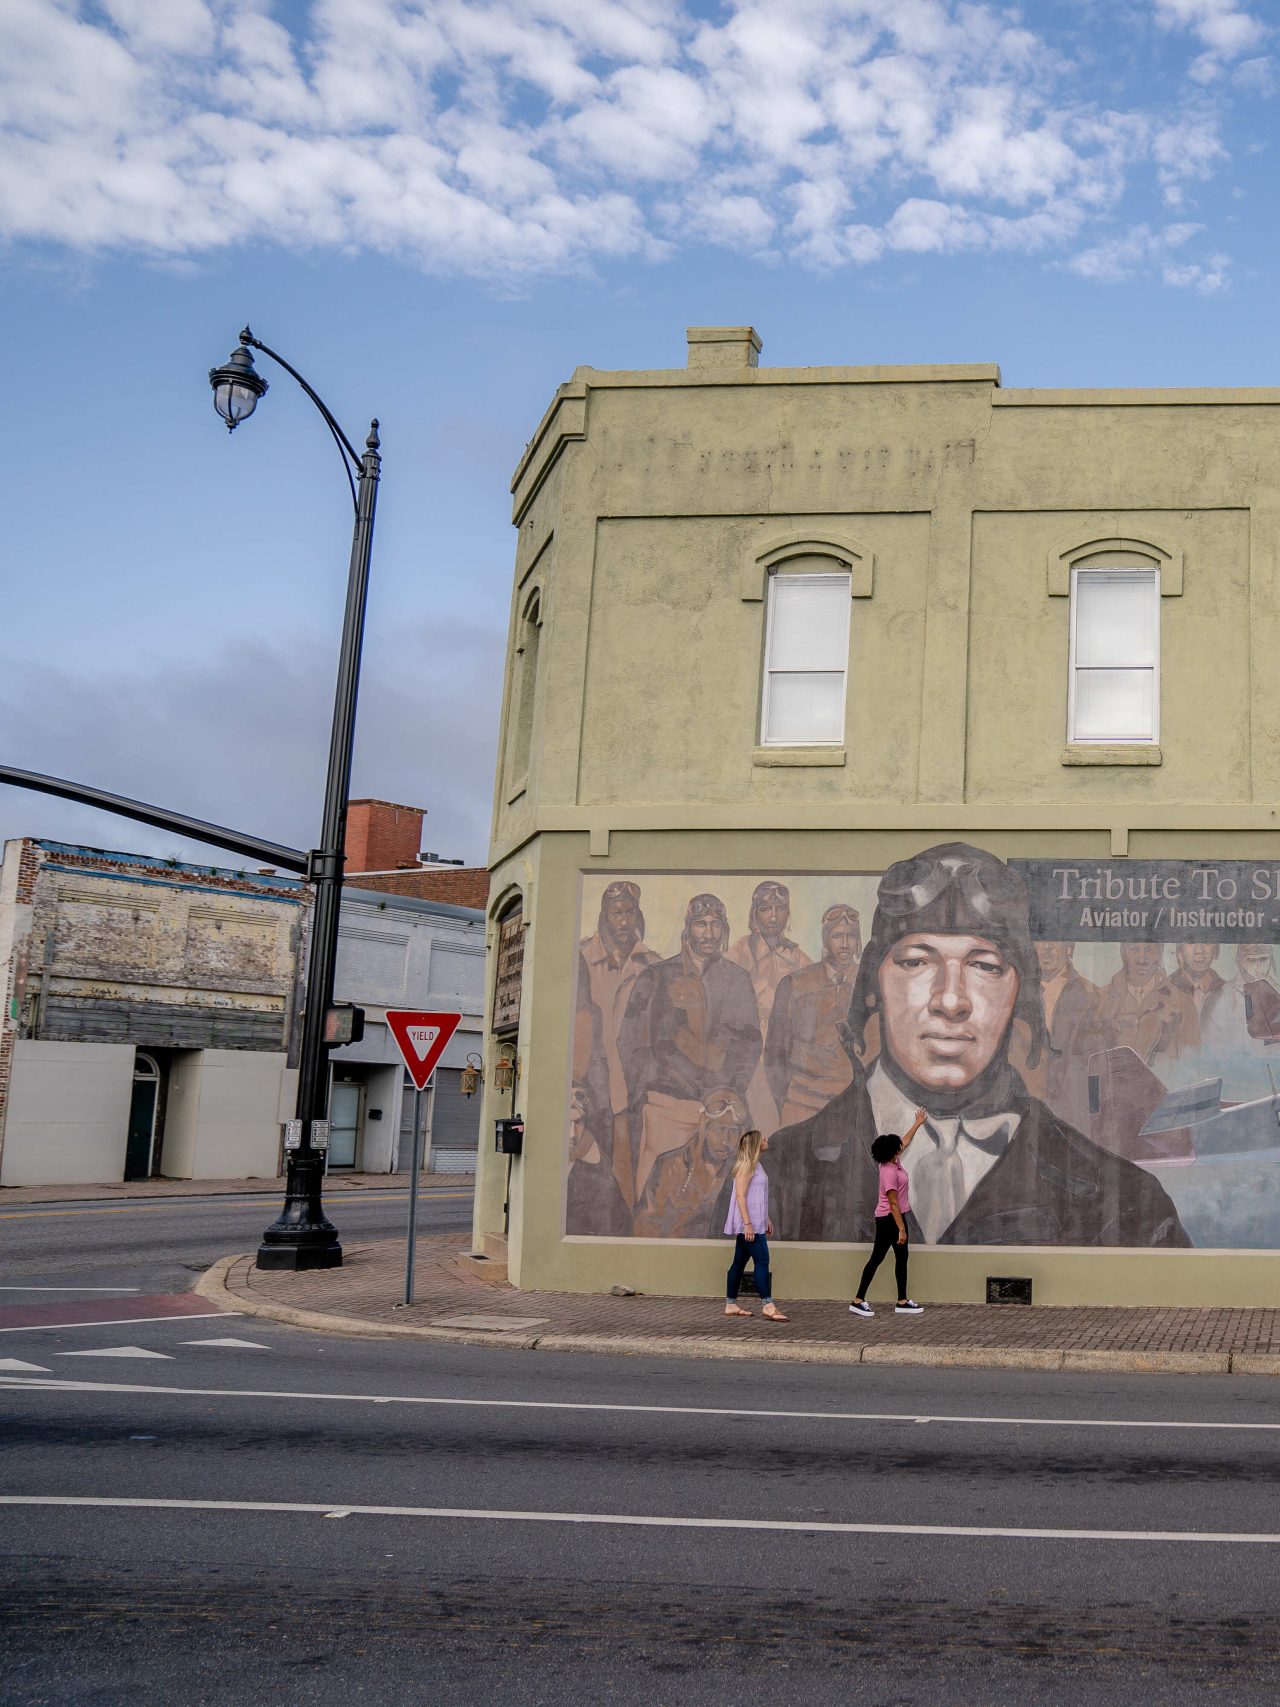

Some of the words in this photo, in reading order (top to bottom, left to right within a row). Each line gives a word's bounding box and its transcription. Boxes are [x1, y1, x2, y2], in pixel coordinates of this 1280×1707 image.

[1052, 868, 1181, 900] Tribute
[1191, 869, 1238, 900] To
[1079, 907, 1149, 928] Aviator
[1154, 907, 1164, 929] /
[1170, 907, 1265, 928] Instructor
[411, 1031, 434, 1041] YIELD
